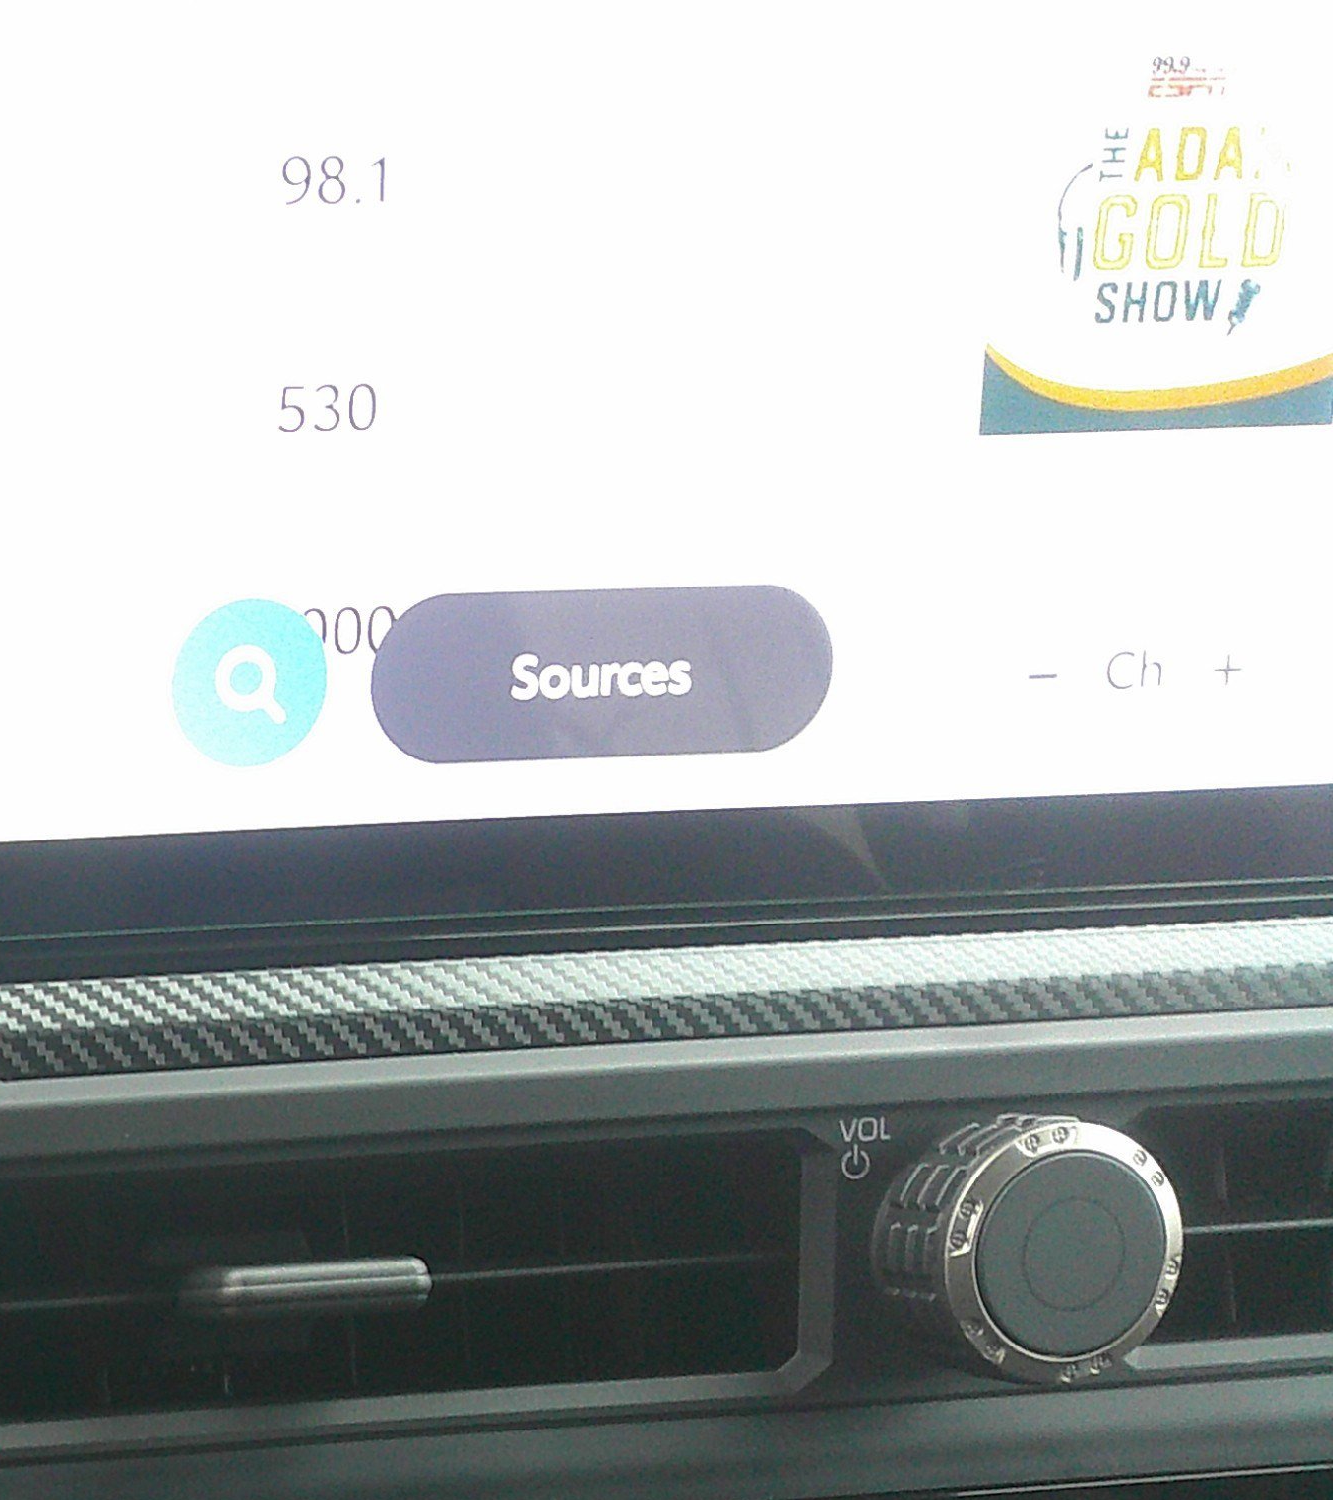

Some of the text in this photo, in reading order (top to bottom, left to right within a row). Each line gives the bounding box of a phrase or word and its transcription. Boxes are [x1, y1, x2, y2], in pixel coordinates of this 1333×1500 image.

[1099, 127, 1129, 182] THE
[1134, 126, 1291, 182] ADA
[281, 156, 387, 205] 98.1
[1093, 192, 1286, 271] GOLD
[1094, 278, 1222, 324] SHOW
[278, 383, 377, 433] 530
[510, 653, 692, 702] Sources
[1107, 650, 1162, 690] Ch
[840, 1117, 891, 1143] VOL
